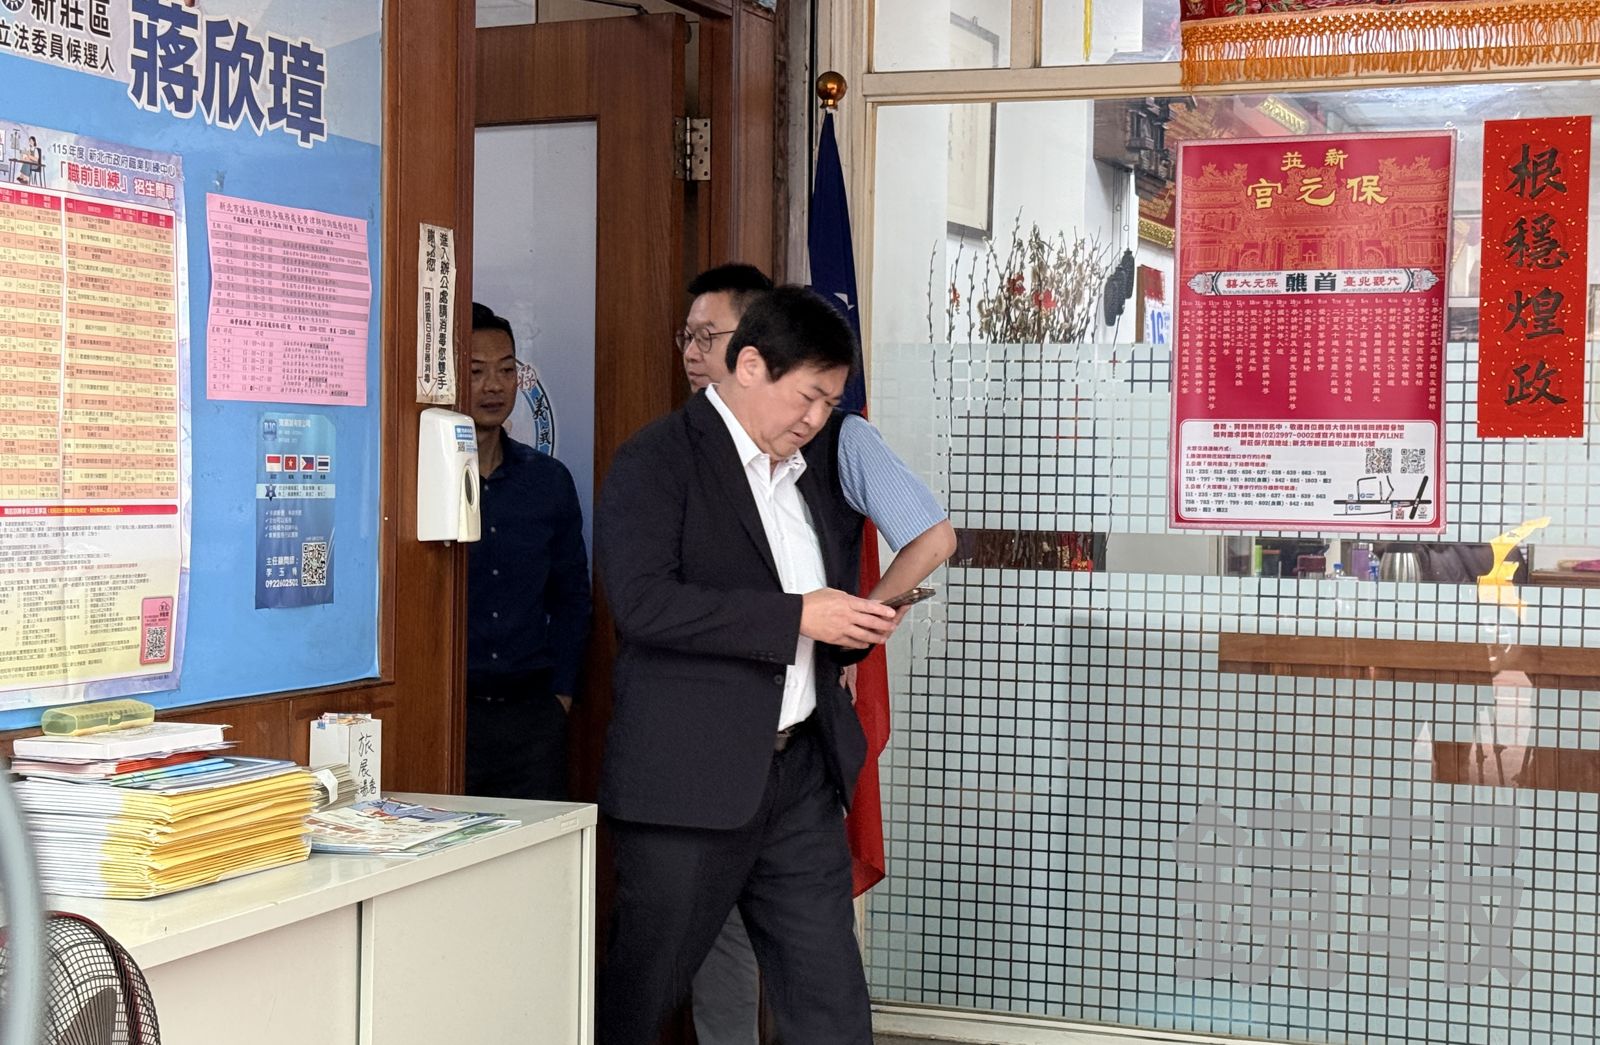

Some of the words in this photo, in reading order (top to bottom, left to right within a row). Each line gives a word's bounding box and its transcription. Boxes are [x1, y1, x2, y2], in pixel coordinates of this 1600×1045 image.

[0, 19, 115, 74] 立法委員候選人
[130, 0, 325, 144] 蔣欣璋
[52, 143, 86, 161] 115年度
[1247, 175, 1389, 210] 保元宮
[1503, 143, 1569, 408] 根穩煌政
